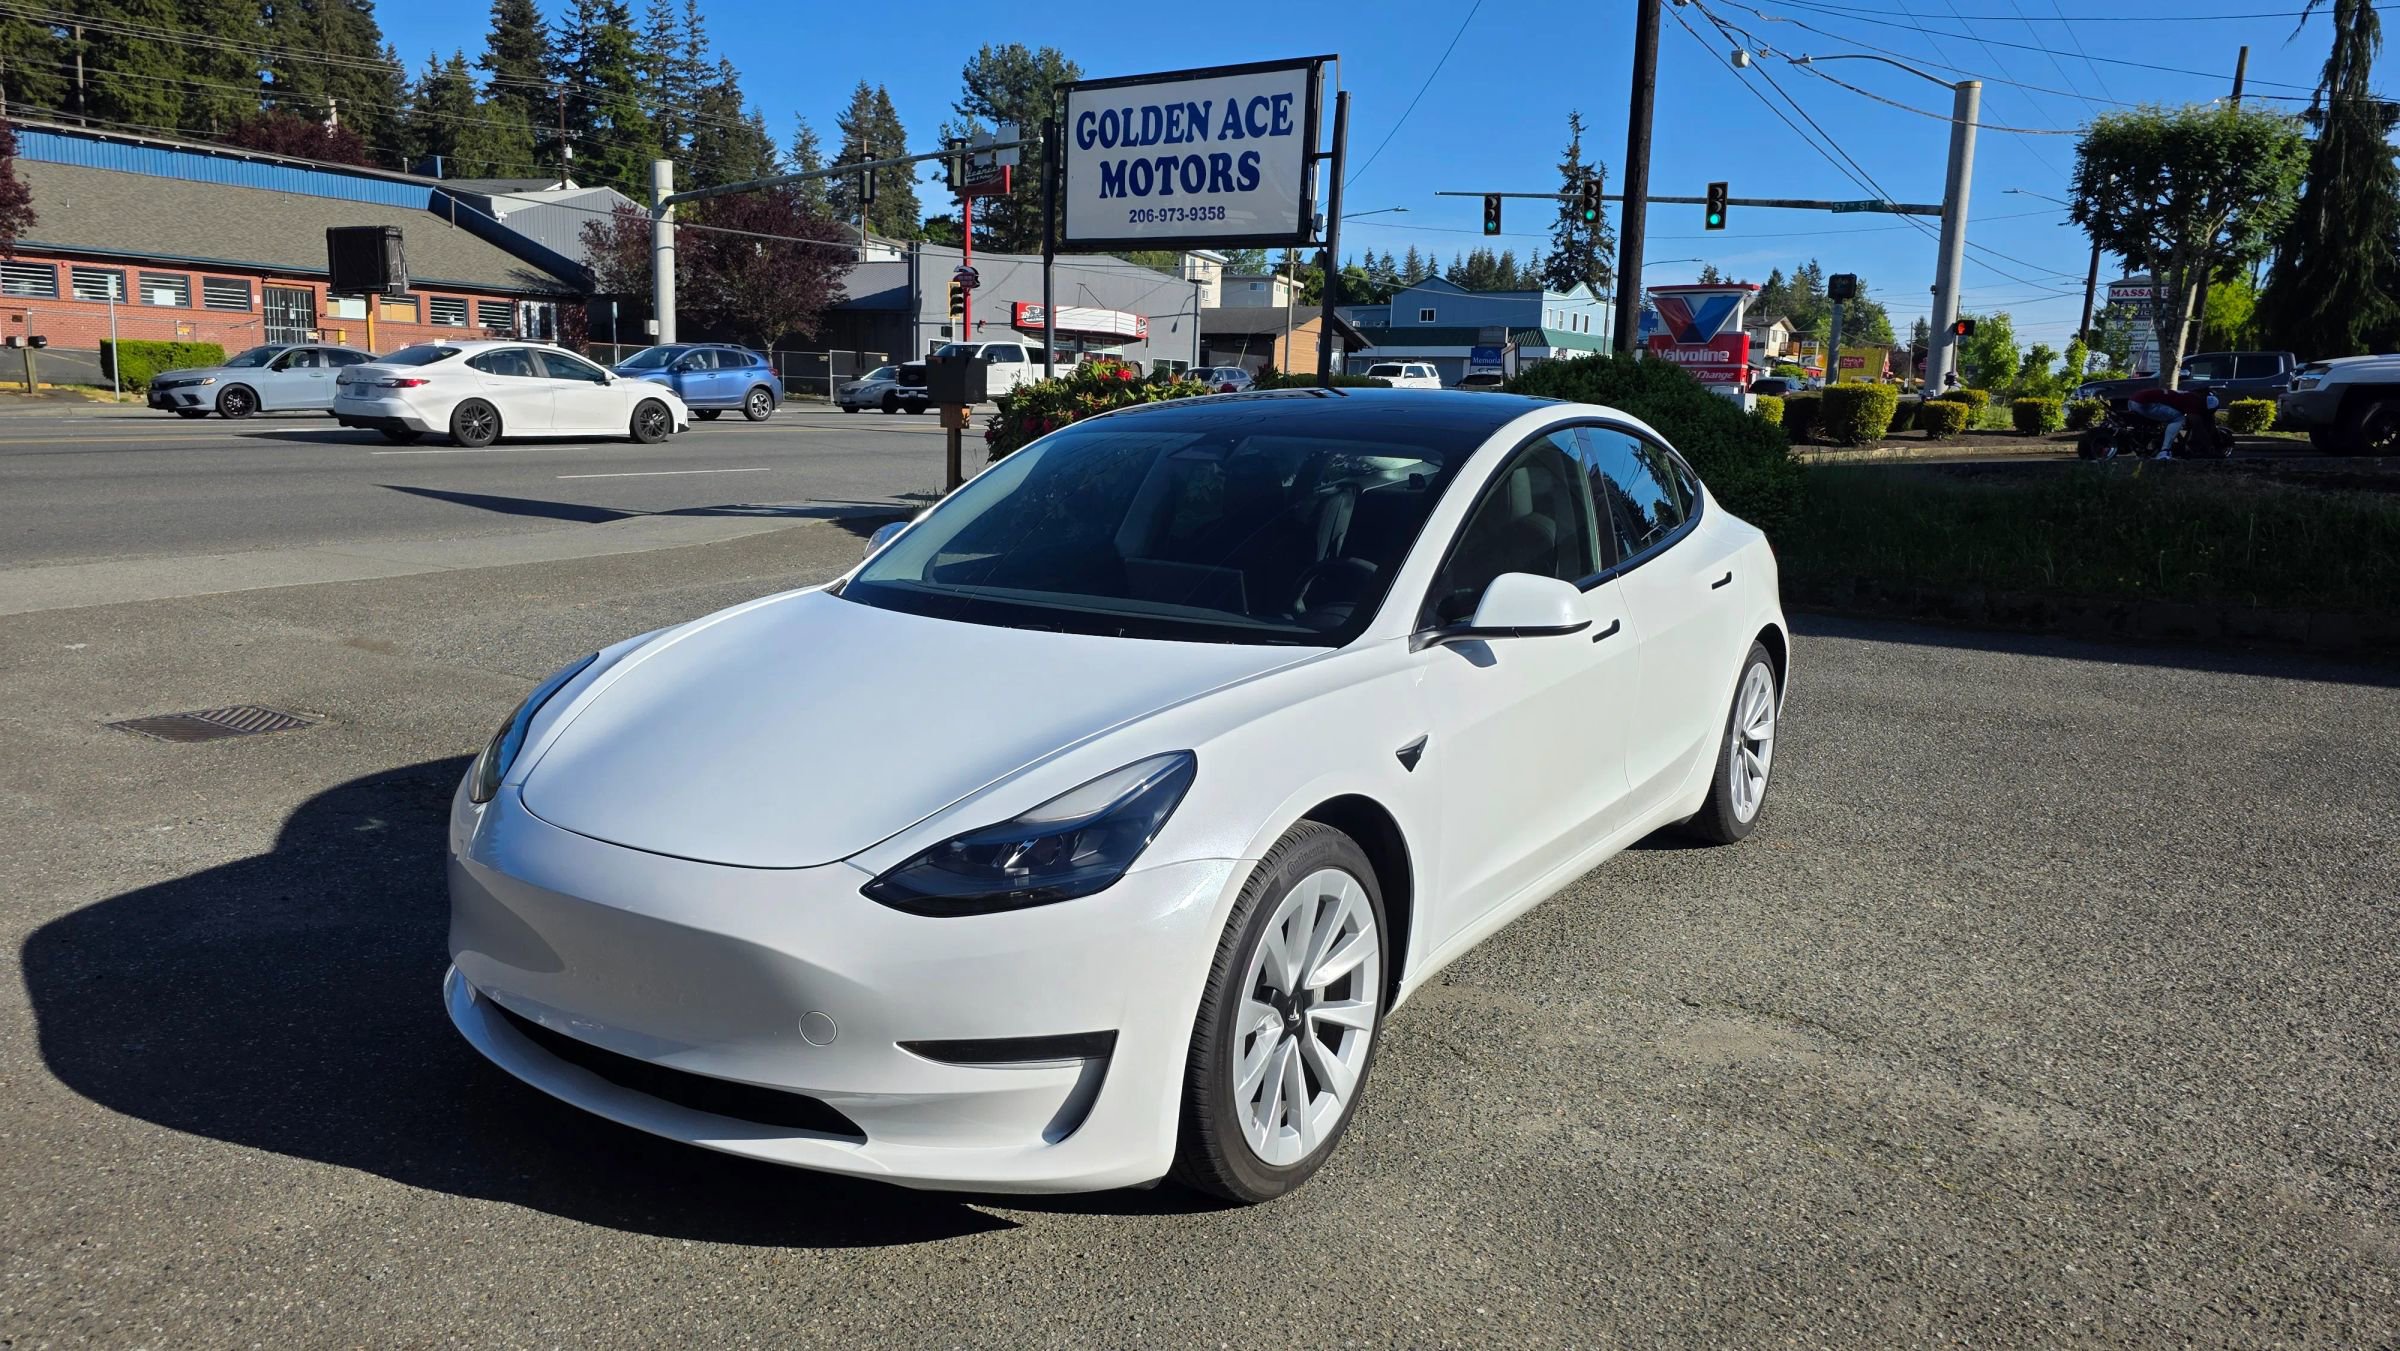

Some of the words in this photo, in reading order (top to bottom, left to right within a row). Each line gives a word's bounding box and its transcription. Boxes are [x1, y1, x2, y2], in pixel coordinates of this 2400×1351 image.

[1076, 100, 1212, 150] GOLDEN
[1217, 92, 1293, 140] ACE
[1099, 150, 1261, 199] MOTORS
[1129, 205, 1226, 223] 206-973-9358
[2111, 289, 2169, 297] MASSAE
[1656, 349, 1730, 362] Valvoline
